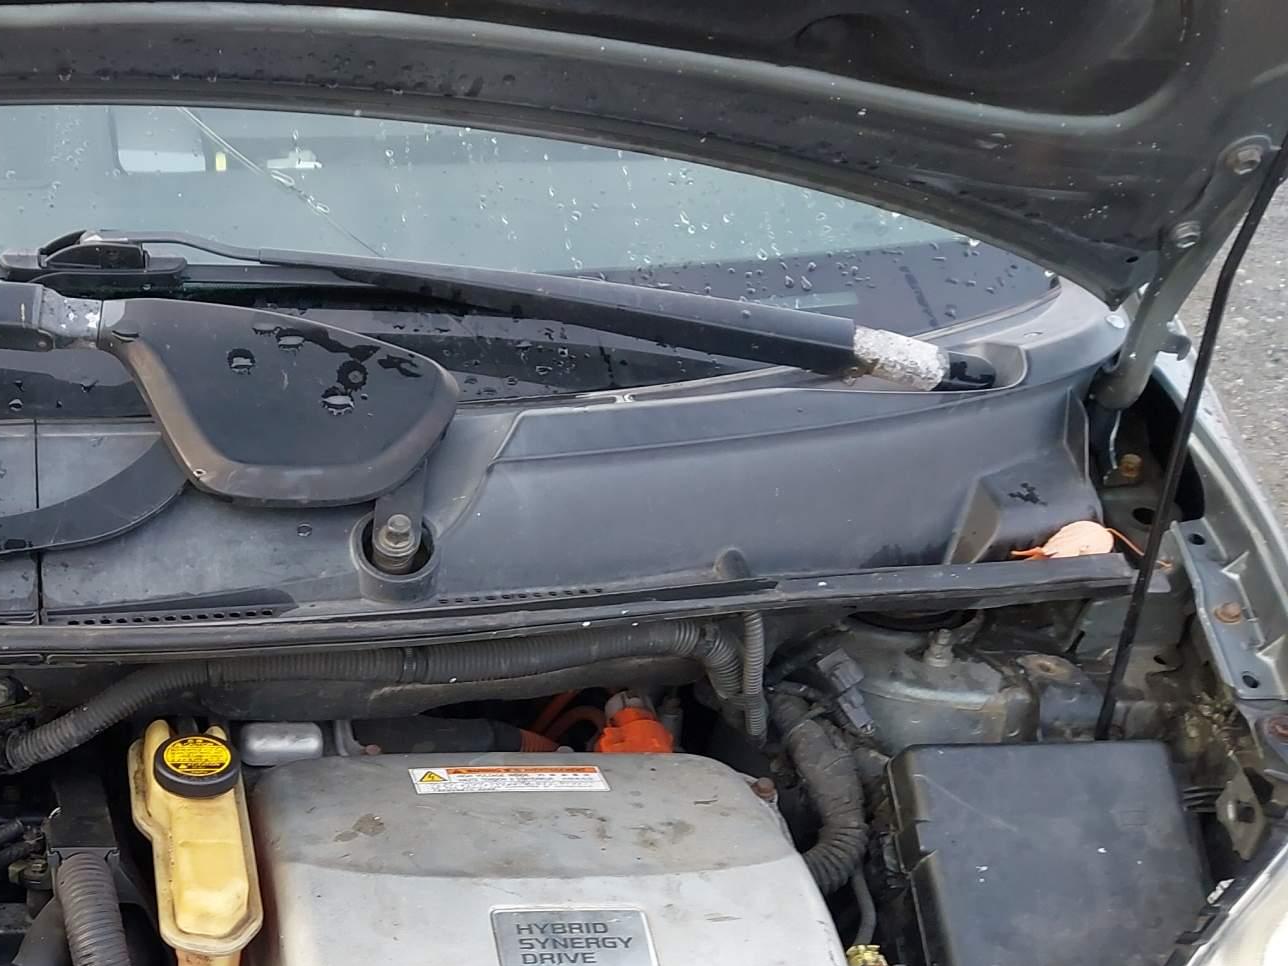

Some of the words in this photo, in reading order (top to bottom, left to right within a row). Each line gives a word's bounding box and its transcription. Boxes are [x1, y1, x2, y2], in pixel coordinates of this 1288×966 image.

[516, 922, 608, 934] HYBRID
[519, 937, 632, 949] SYNERGY
[521, 952, 597, 964] DRIVE
